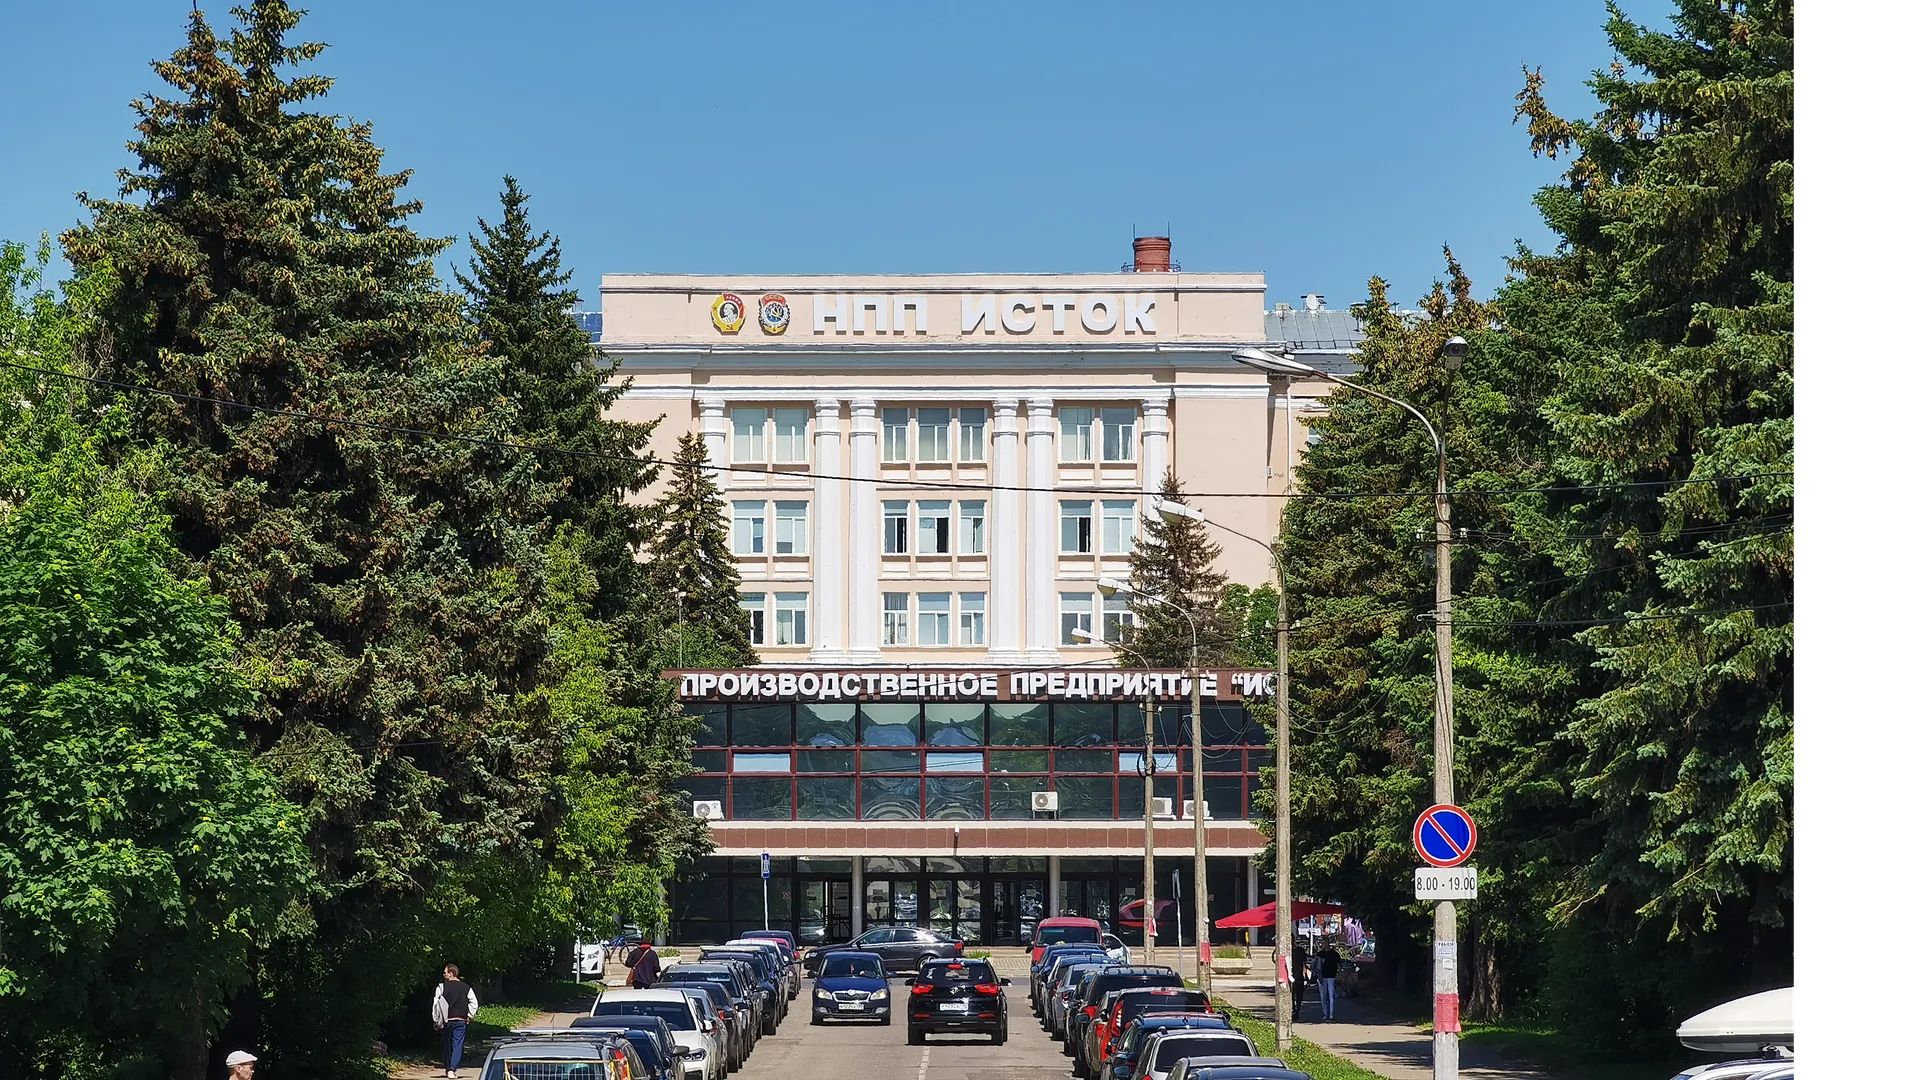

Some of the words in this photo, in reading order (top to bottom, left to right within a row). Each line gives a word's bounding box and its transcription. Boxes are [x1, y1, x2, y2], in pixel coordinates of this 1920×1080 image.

[813, 295, 927, 334] НПП
[961, 295, 1156, 335] ИСТОК
[680, 673, 998, 699] ПРОИЗВОДСТВЕННОЕ
[1416, 876, 1438, 890] 8.00
[1448, 876, 1475, 890] 19.00
